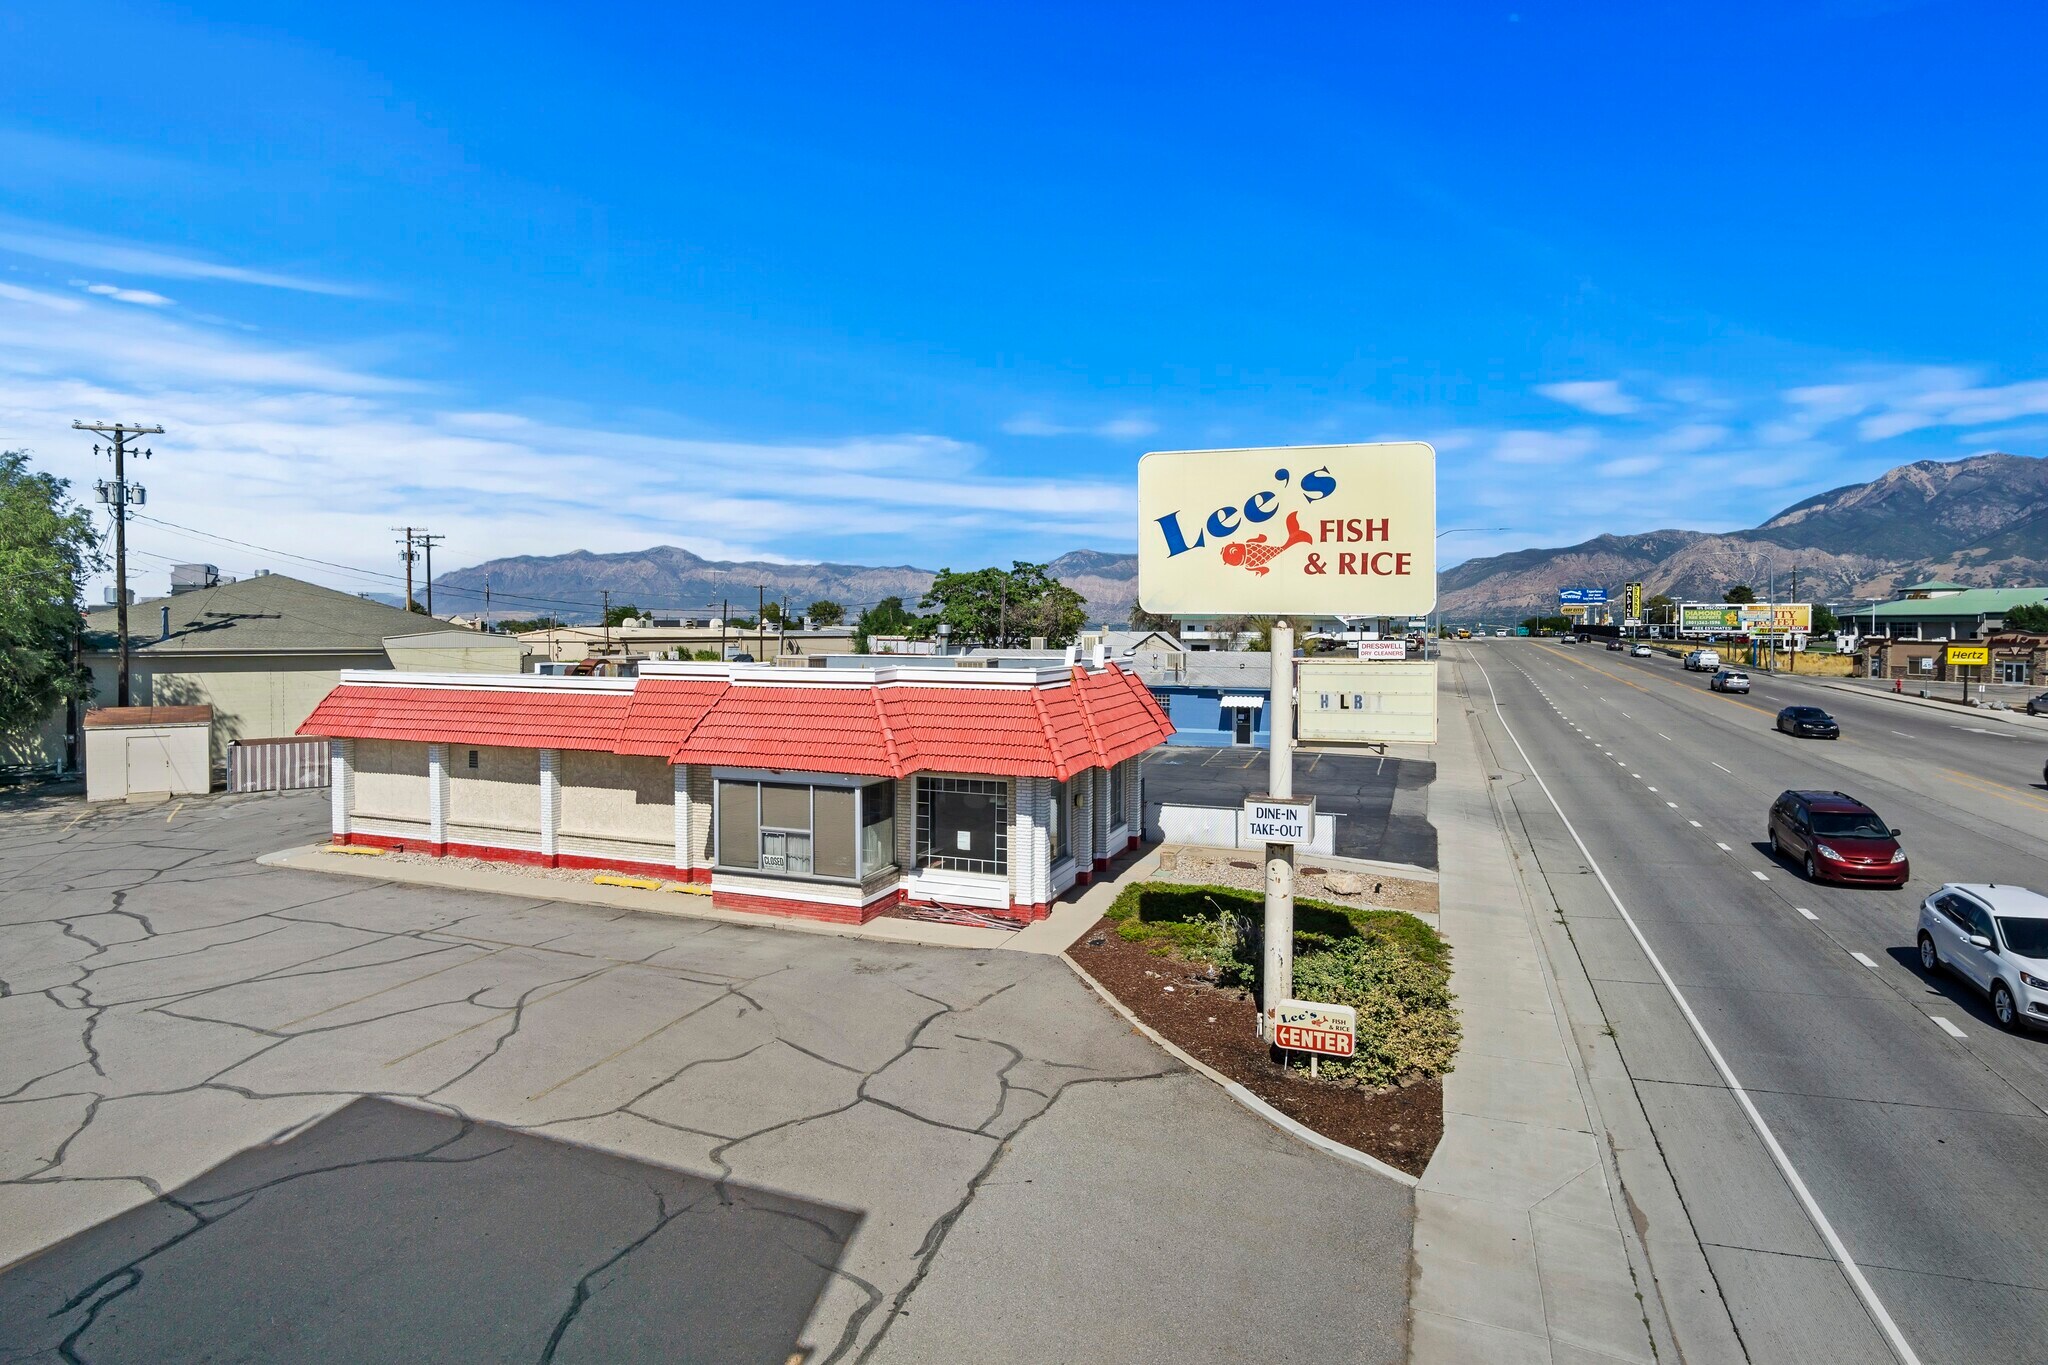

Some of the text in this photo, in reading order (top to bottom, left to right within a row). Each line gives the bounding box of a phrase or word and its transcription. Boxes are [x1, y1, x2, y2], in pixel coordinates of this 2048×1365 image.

[1154, 465, 1337, 558] Lee's
[1320, 518, 1389, 542] FISH
[1304, 552, 1411, 575] & RICE
[1952, 651, 1984, 660] Hertz
[1256, 807, 1297, 820] DINE-IN
[1250, 823, 1303, 837] TAKE-OUT
[764, 856, 784, 866] CLOSED
[1280, 1010, 1317, 1023] Lee's
[1289, 1028, 1349, 1053] ENTER
